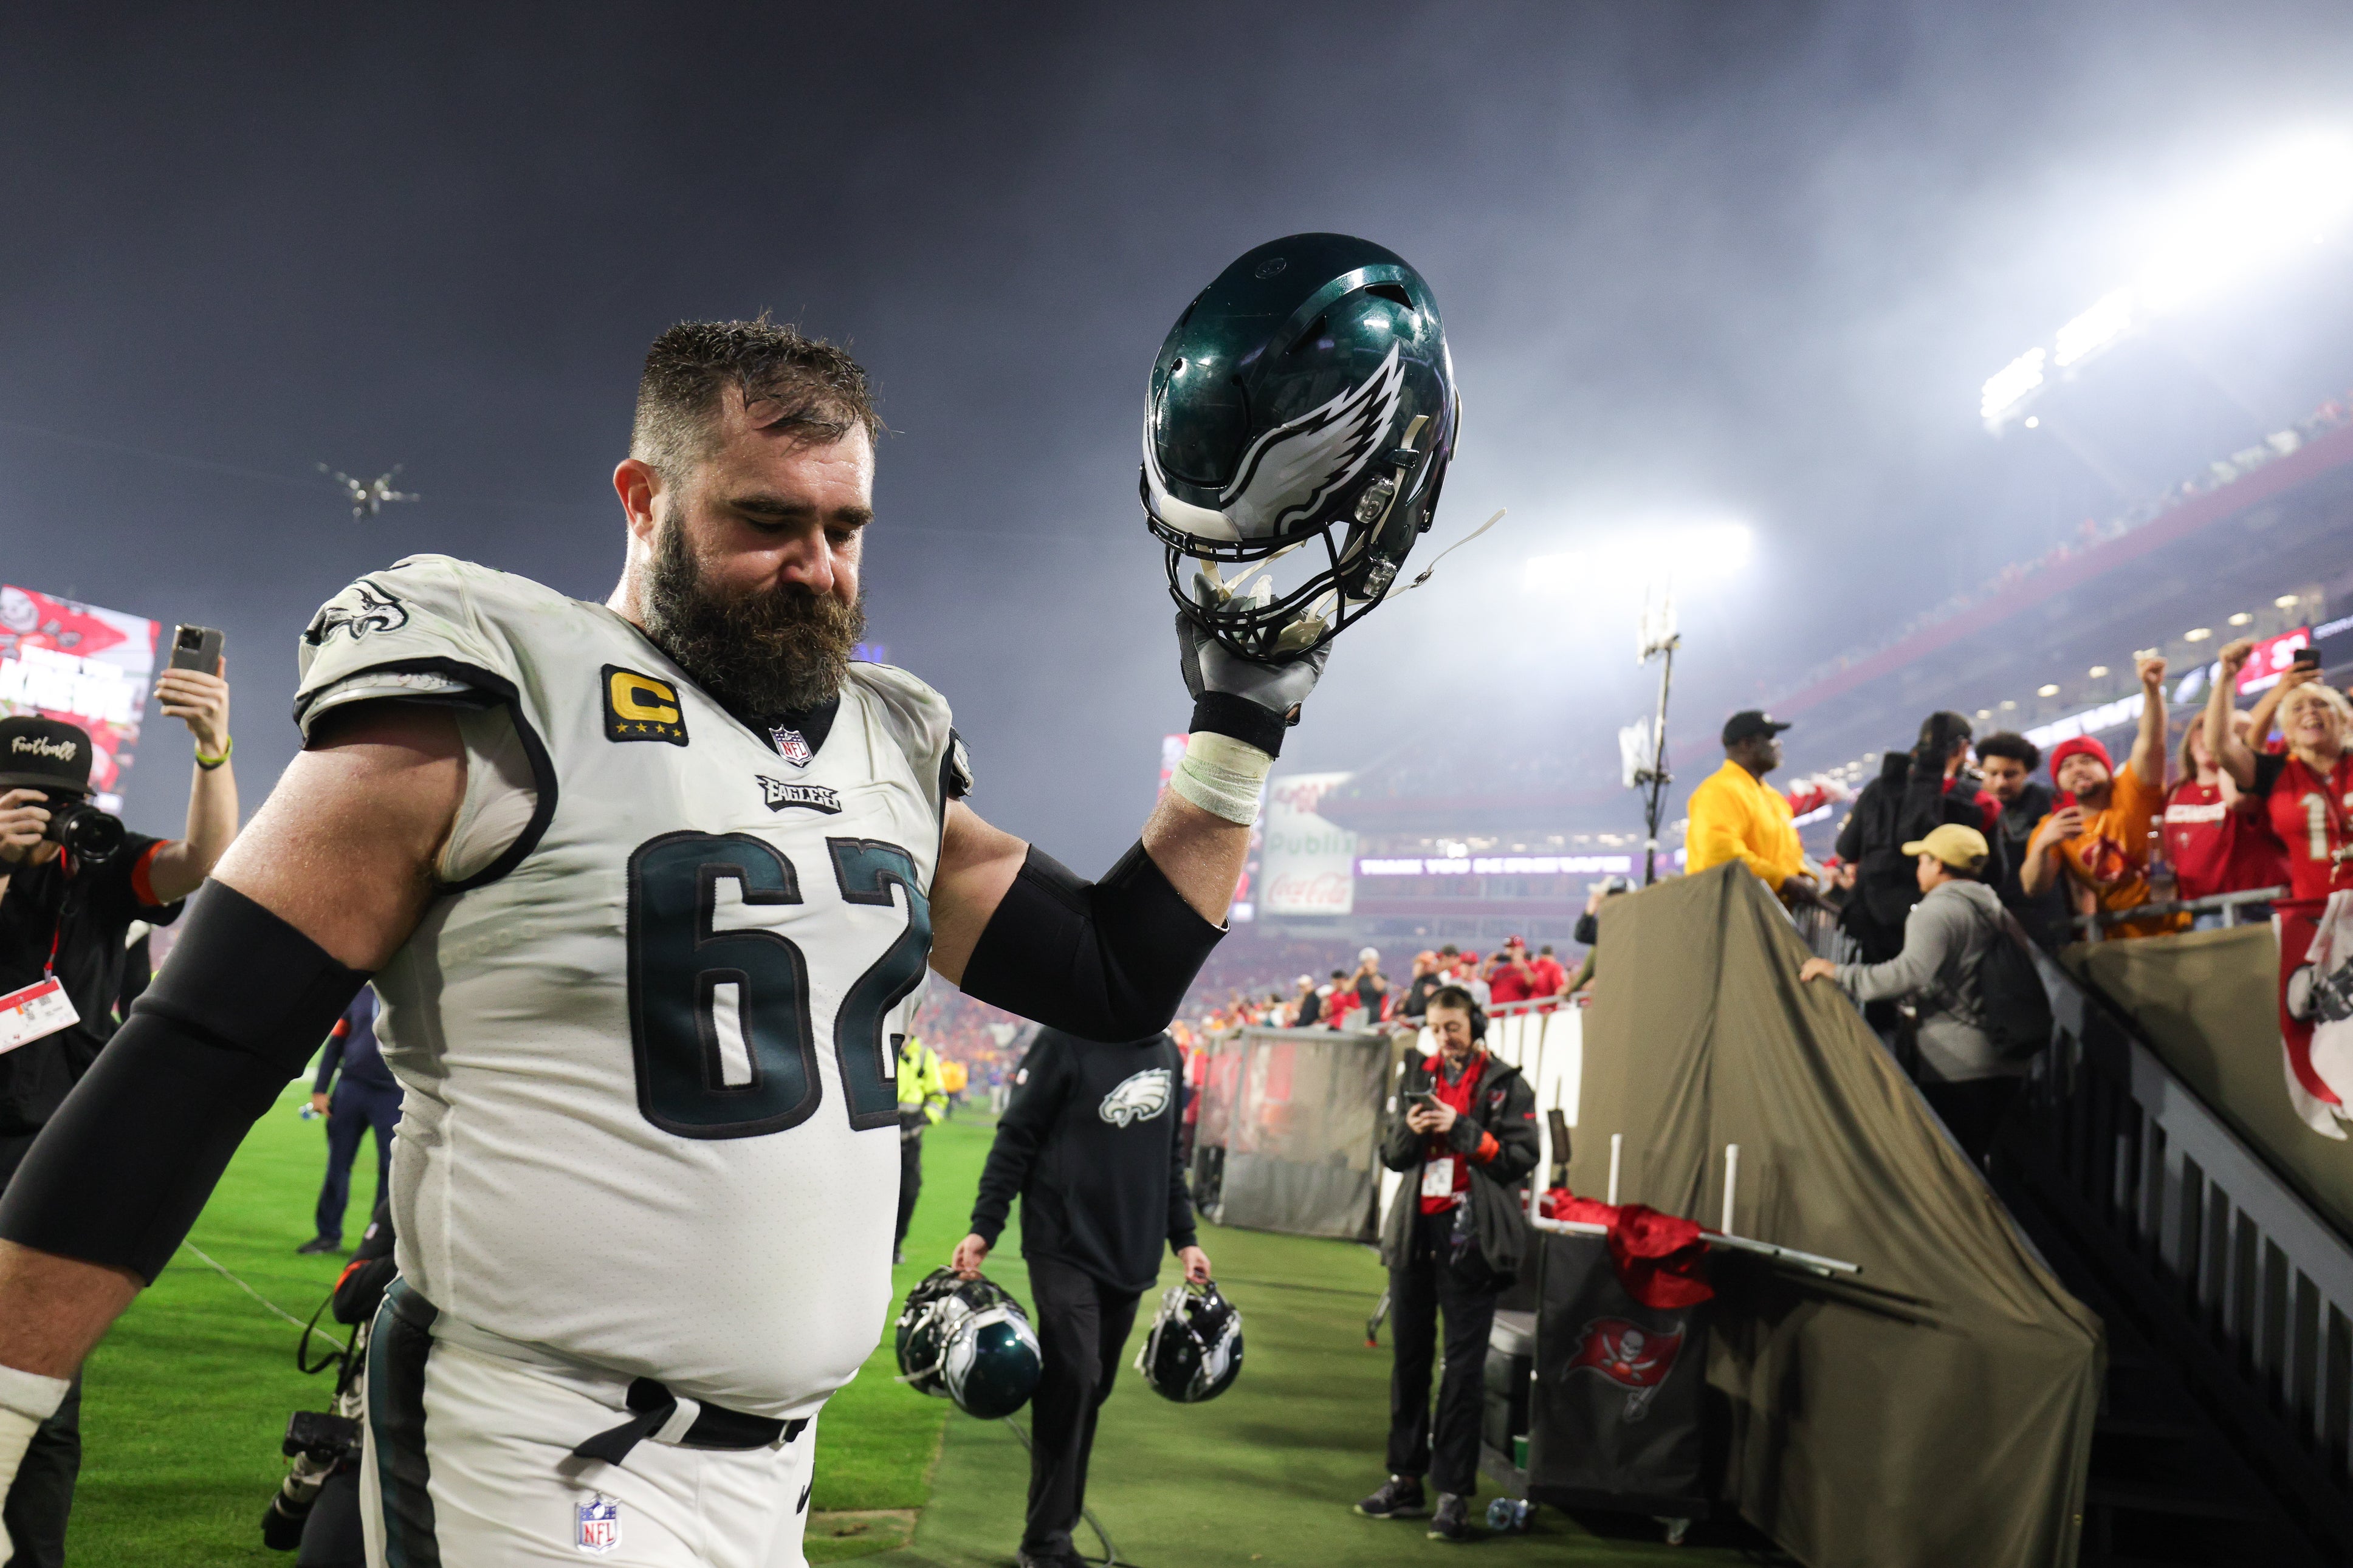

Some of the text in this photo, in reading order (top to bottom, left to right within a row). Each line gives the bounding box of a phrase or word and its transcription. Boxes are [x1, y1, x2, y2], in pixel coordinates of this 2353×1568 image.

[611, 672, 679, 724] C
[12, 736, 77, 761] Football
[780, 741, 806, 761] NFL
[755, 775, 842, 814] EAGLES
[627, 830, 933, 1140] 62
[584, 1522, 614, 1545] NFL
